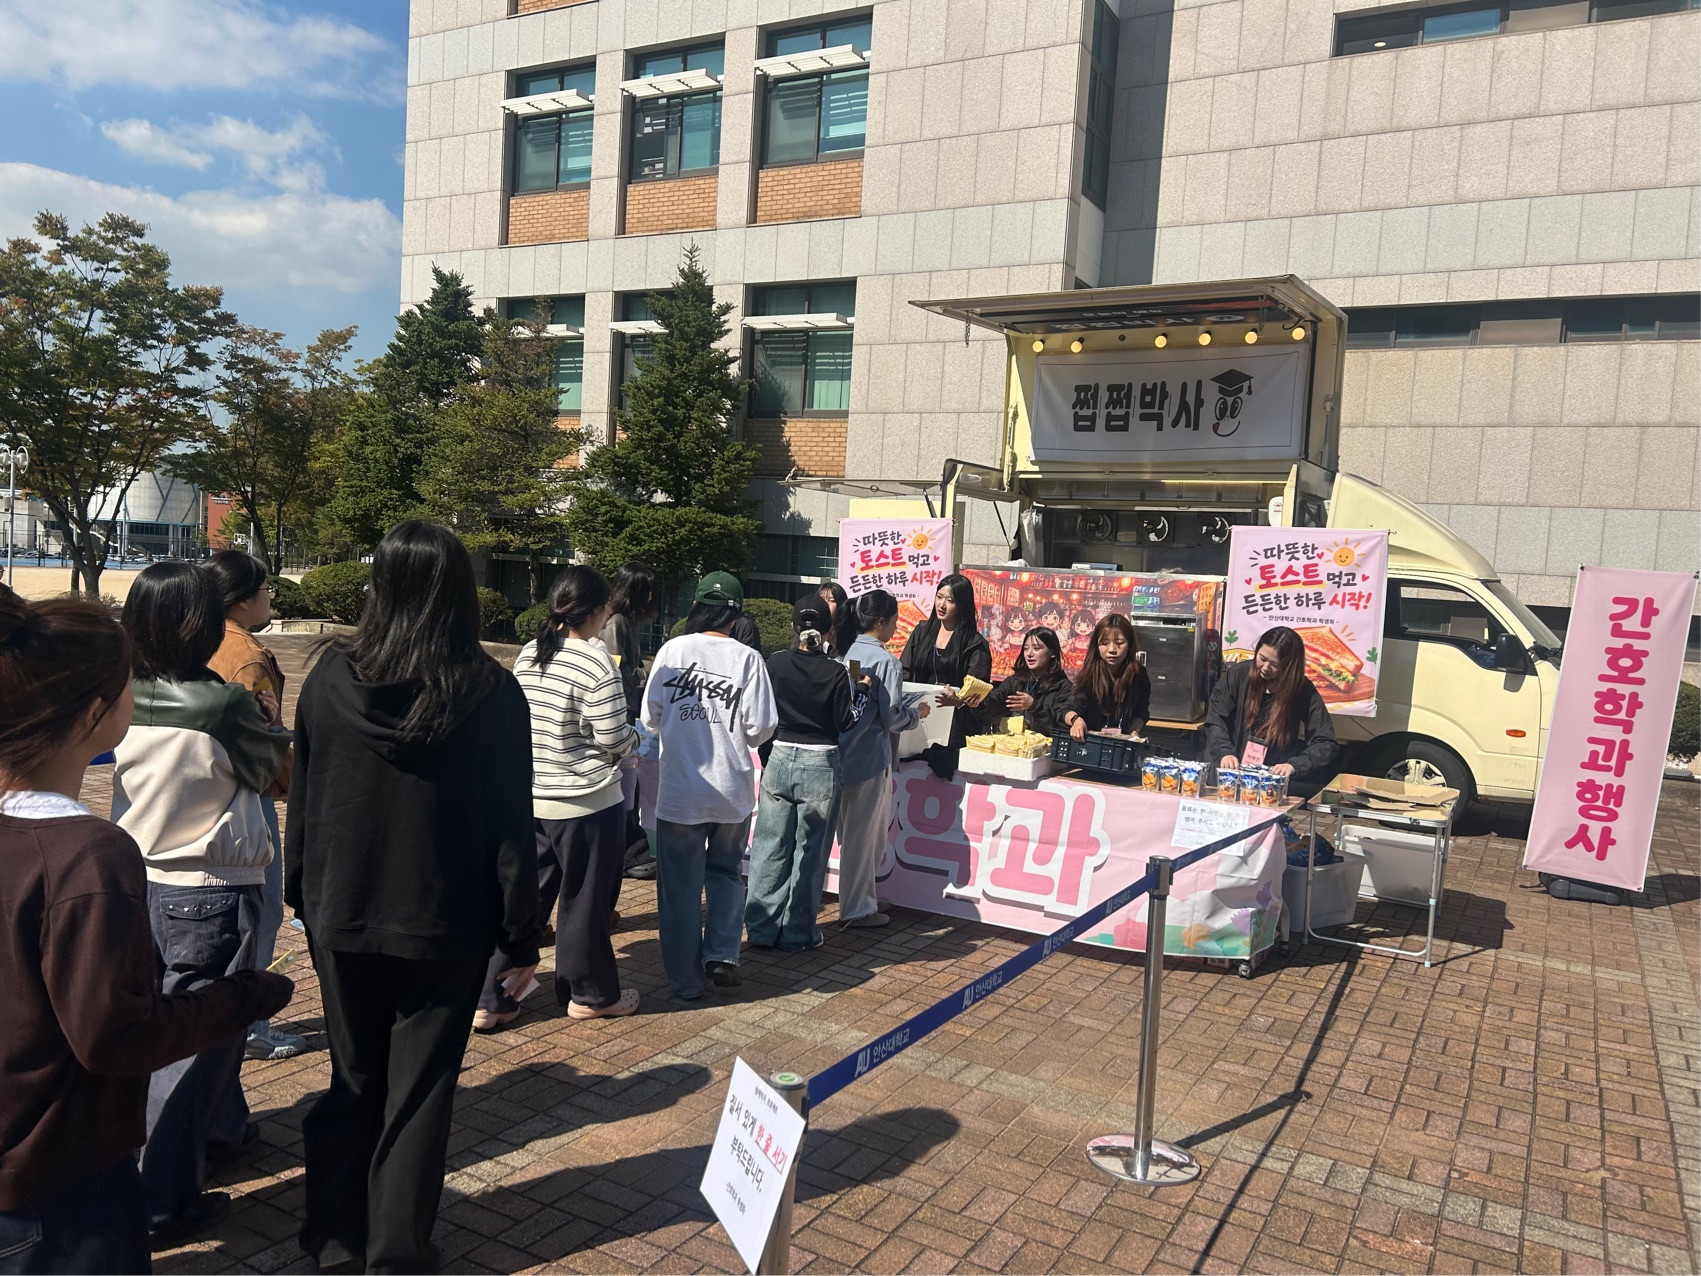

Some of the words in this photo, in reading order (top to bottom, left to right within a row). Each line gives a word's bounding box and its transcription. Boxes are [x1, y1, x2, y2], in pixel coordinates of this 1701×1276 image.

[1072, 379, 1205, 432] 쩝쩝박사
[862, 531, 902, 547] 따뜻한
[1262, 542, 1318, 561] 따뜻한
[860, 547, 907, 571] 토스트
[908, 553, 931, 568] 먹고
[849, 573, 883, 593] 든든한
[885, 571, 909, 587] 하루
[910, 570, 943, 586] 시작!
[1258, 563, 1323, 589] 토스트
[1326, 570, 1358, 589] 먹고
[1242, 593, 1290, 615] 든든한
[1294, 591, 1326, 610] 하루
[1328, 591, 1373, 611] 시작!
[962, 985, 974, 1010] AU
[975, 970, 1003, 999] 안산대학교
[854, 1046, 870, 1078] AU
[873, 1028, 910, 1063] 안산대학교
[728, 1093, 743, 1120] 질서
[743, 1108, 757, 1139] 있게
[756, 1123, 766, 1146] 한
[763, 1132, 774, 1156] 줄
[772, 1144, 788, 1173] 서기
[730, 1134, 765, 1193] 부탁드립니다.
